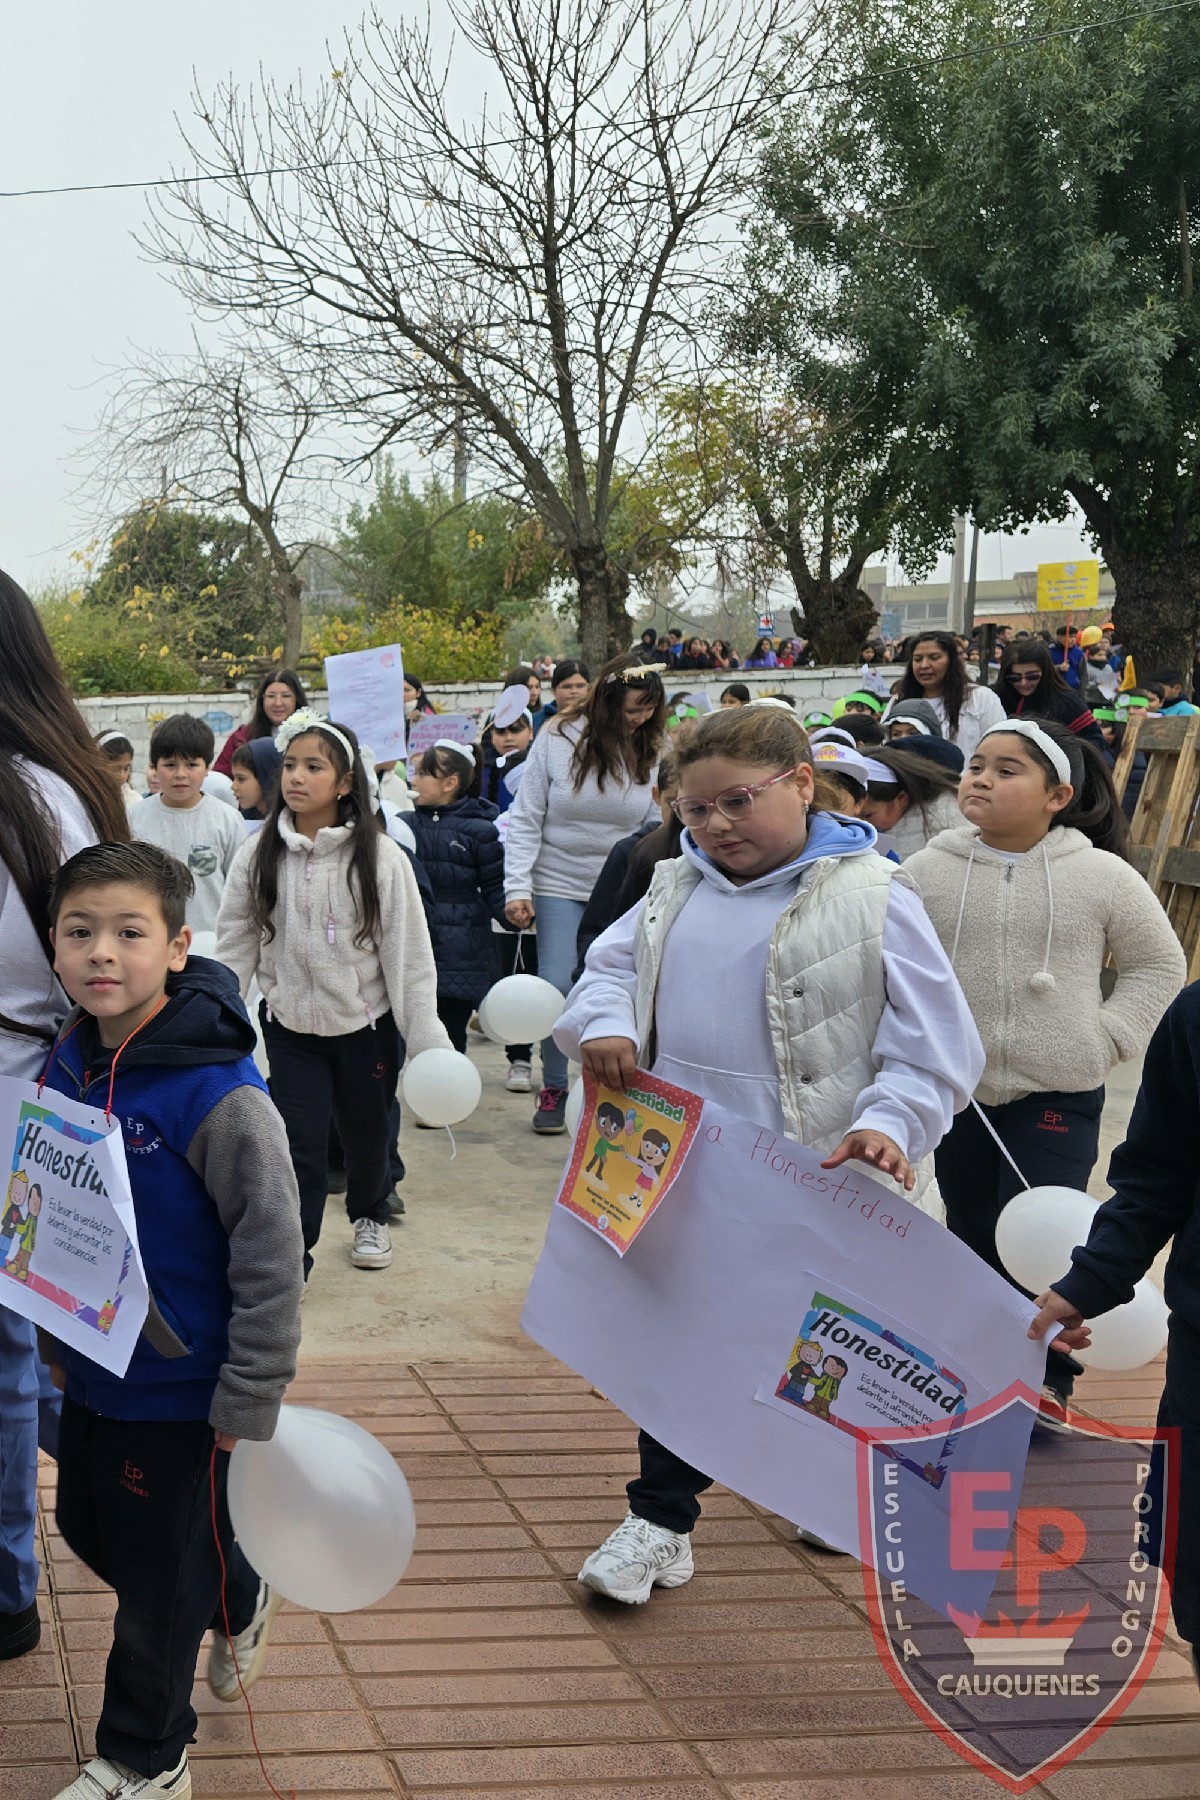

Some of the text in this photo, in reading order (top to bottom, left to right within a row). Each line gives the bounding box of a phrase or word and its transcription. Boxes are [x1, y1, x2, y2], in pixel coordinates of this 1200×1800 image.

[126, 1116, 145, 1135] EP
[750, 1131, 912, 1238] Honestidad
[809, 1311, 965, 1415] Honestidad
